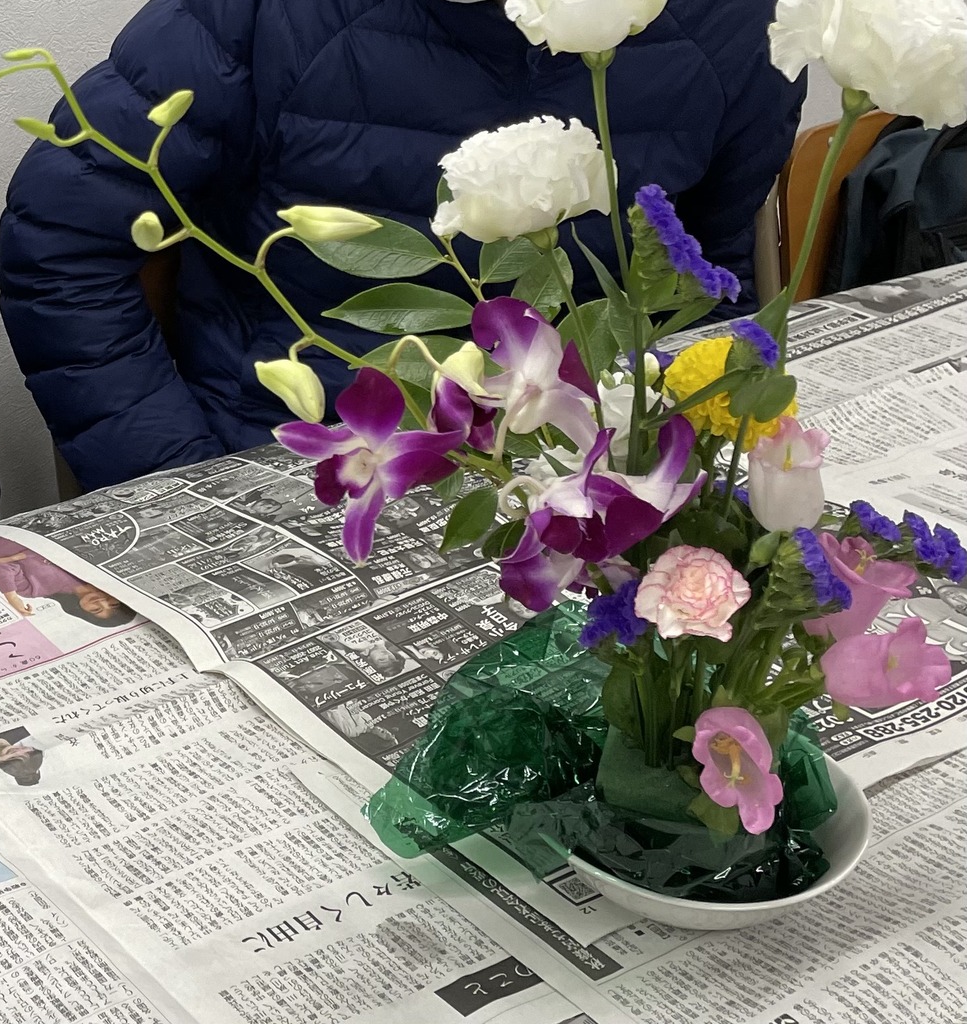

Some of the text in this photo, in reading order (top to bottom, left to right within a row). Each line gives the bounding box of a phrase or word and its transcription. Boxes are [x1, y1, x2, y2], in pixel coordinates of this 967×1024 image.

[80, 525, 104, 540] MAN
[90, 520, 132, 546] TARO
[406, 611, 448, 633] 中森明菜
[437, 637, 487, 665] テレサ・テン
[312, 677, 367, 708] チューリップ
[241, 870, 422, 953] 若々しく自由に
[577, 905, 597, 916] 12
